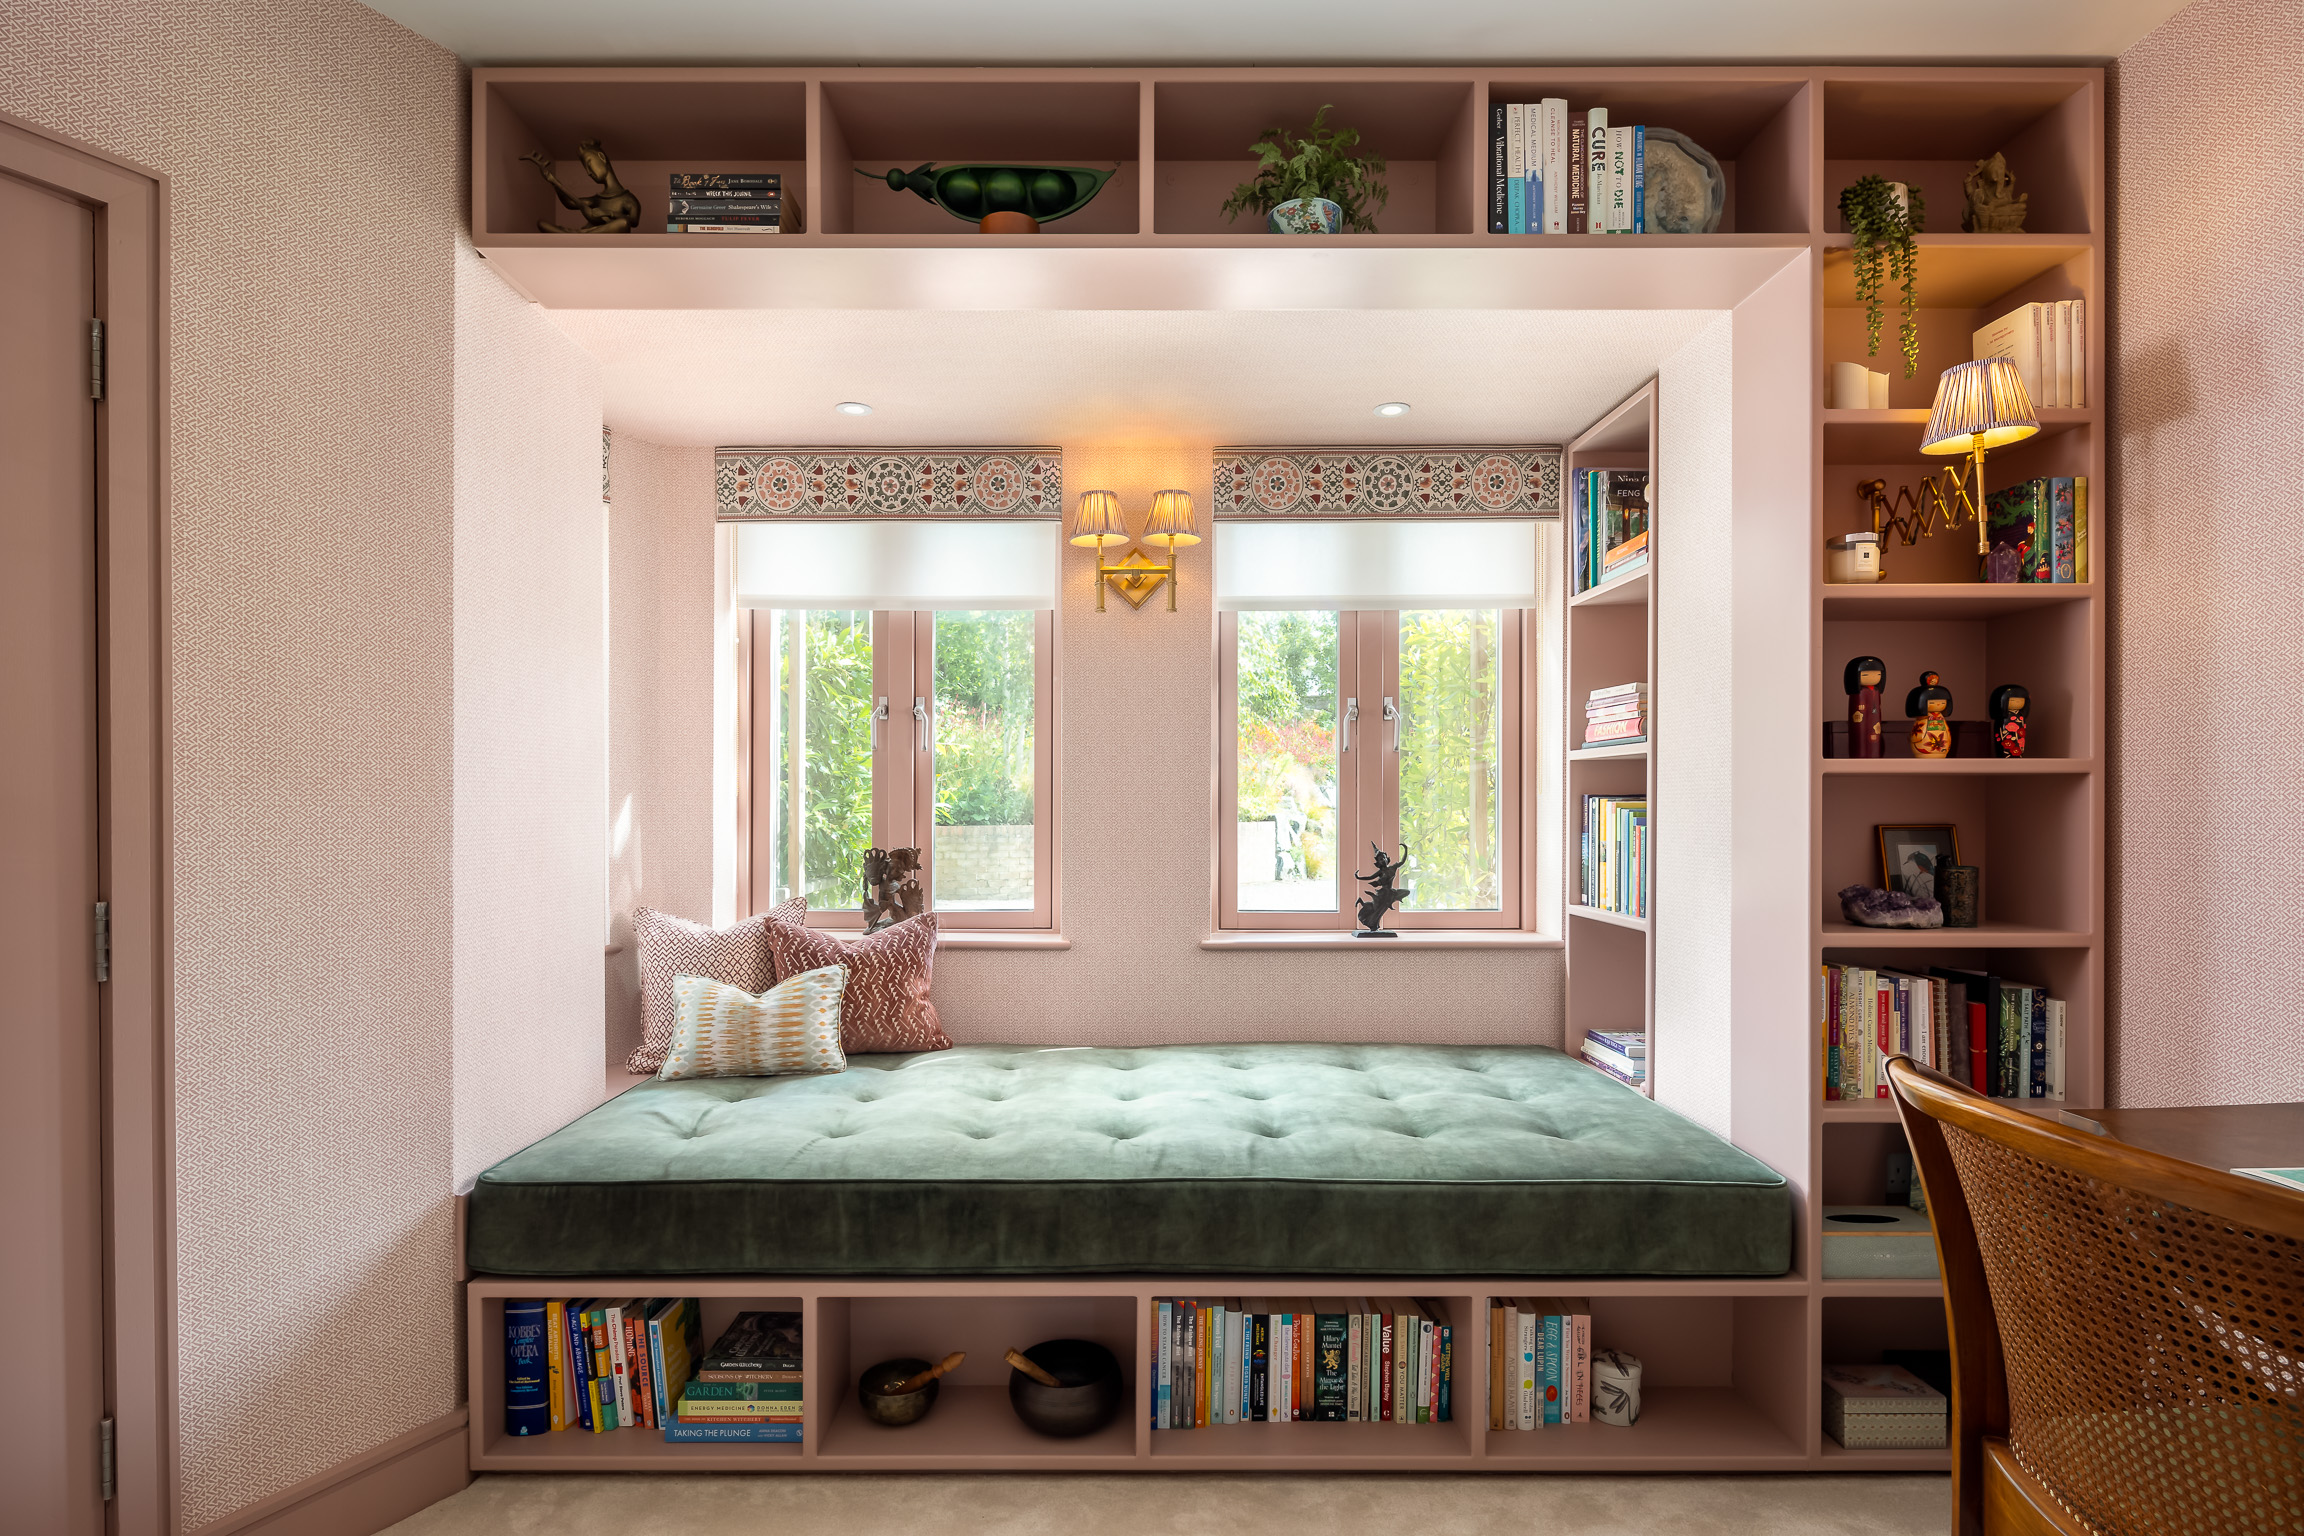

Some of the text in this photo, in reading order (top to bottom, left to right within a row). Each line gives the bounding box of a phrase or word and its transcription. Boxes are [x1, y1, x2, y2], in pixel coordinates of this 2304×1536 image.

[1496, 108, 1504, 129] Gerber
[1550, 138, 1556, 147] TO
[1572, 129, 1580, 163] NATURAL
[1591, 127, 1606, 172] CURE
[1615, 130, 1624, 149] HOW
[1615, 151, 1624, 176] NOT
[1495, 136, 1505, 214] Vibrational Medicine
[1572, 163, 1580, 200] MEDICINE
[1615, 177, 1624, 188] TO
[1615, 190, 1624, 208] DIE
[1617, 489, 1640, 497] FENG
[1594, 721, 1628, 736] FASHION
[625, 1326, 635, 1356] HOMING
[1162, 1328, 1168, 1336] TO
[1322, 1335, 1341, 1343] Hilary
[1382, 1325, 1392, 1354] Value
[1546, 1321, 1558, 1341] EGG
[510, 1345, 539, 1357] OPERA
[575, 1347, 583, 1375] ABUSAGE
[637, 1333, 649, 1387] THE SOURCE
[1546, 1351, 1558, 1382] SPOON
[1575, 1347, 1586, 1406] GIRL IN PIECES
[686, 1386, 733, 1396] GARDEN
[1330, 1384, 1344, 1392] Light
[674, 1429, 751, 1437] TAKING THE PLUNGE
